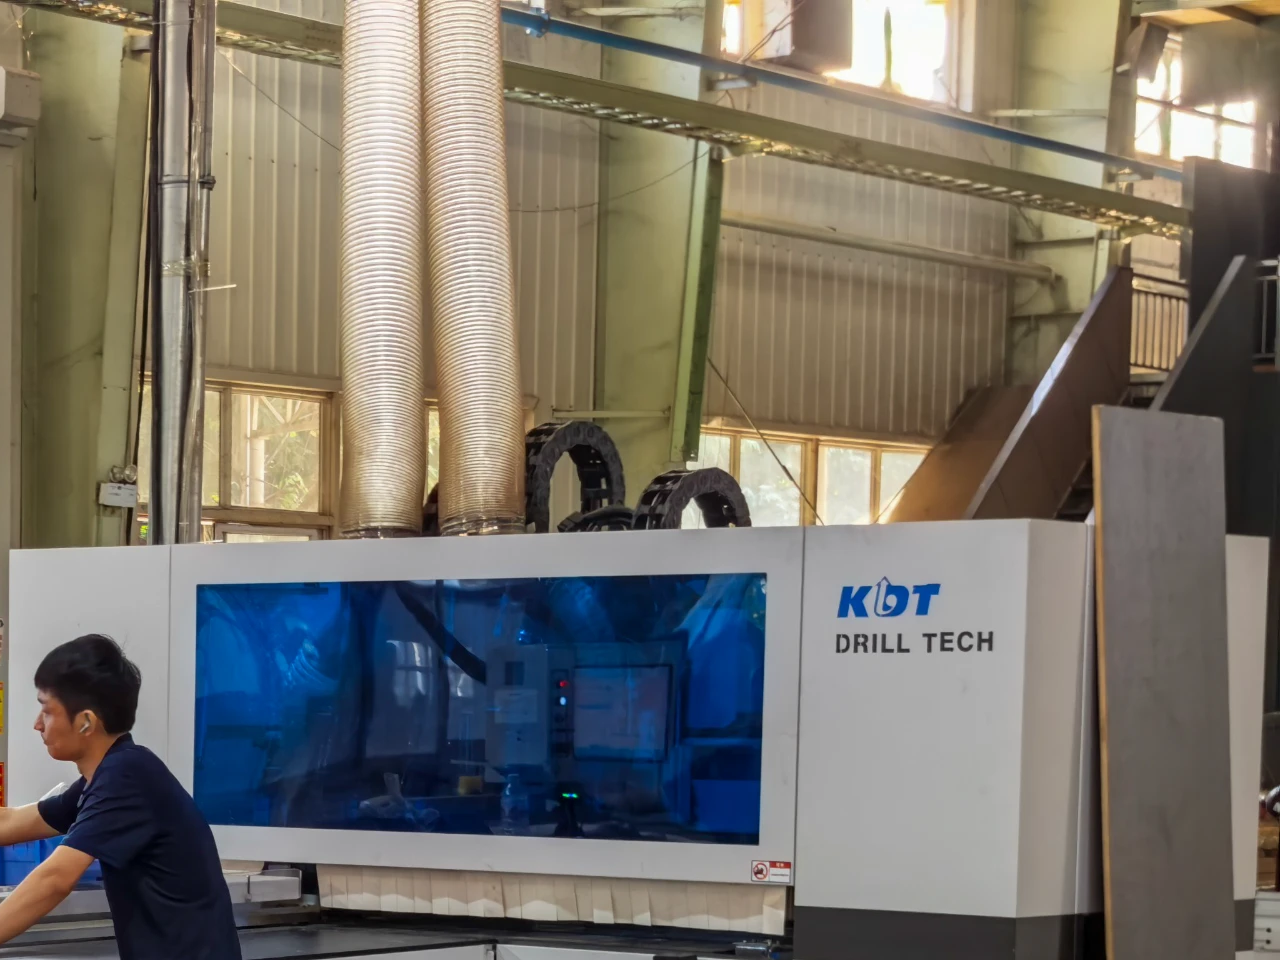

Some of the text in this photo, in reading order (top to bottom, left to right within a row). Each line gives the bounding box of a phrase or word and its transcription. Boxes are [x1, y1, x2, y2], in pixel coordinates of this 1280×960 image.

[837, 578, 941, 618] KDT
[835, 631, 994, 654] DRILL TECH
